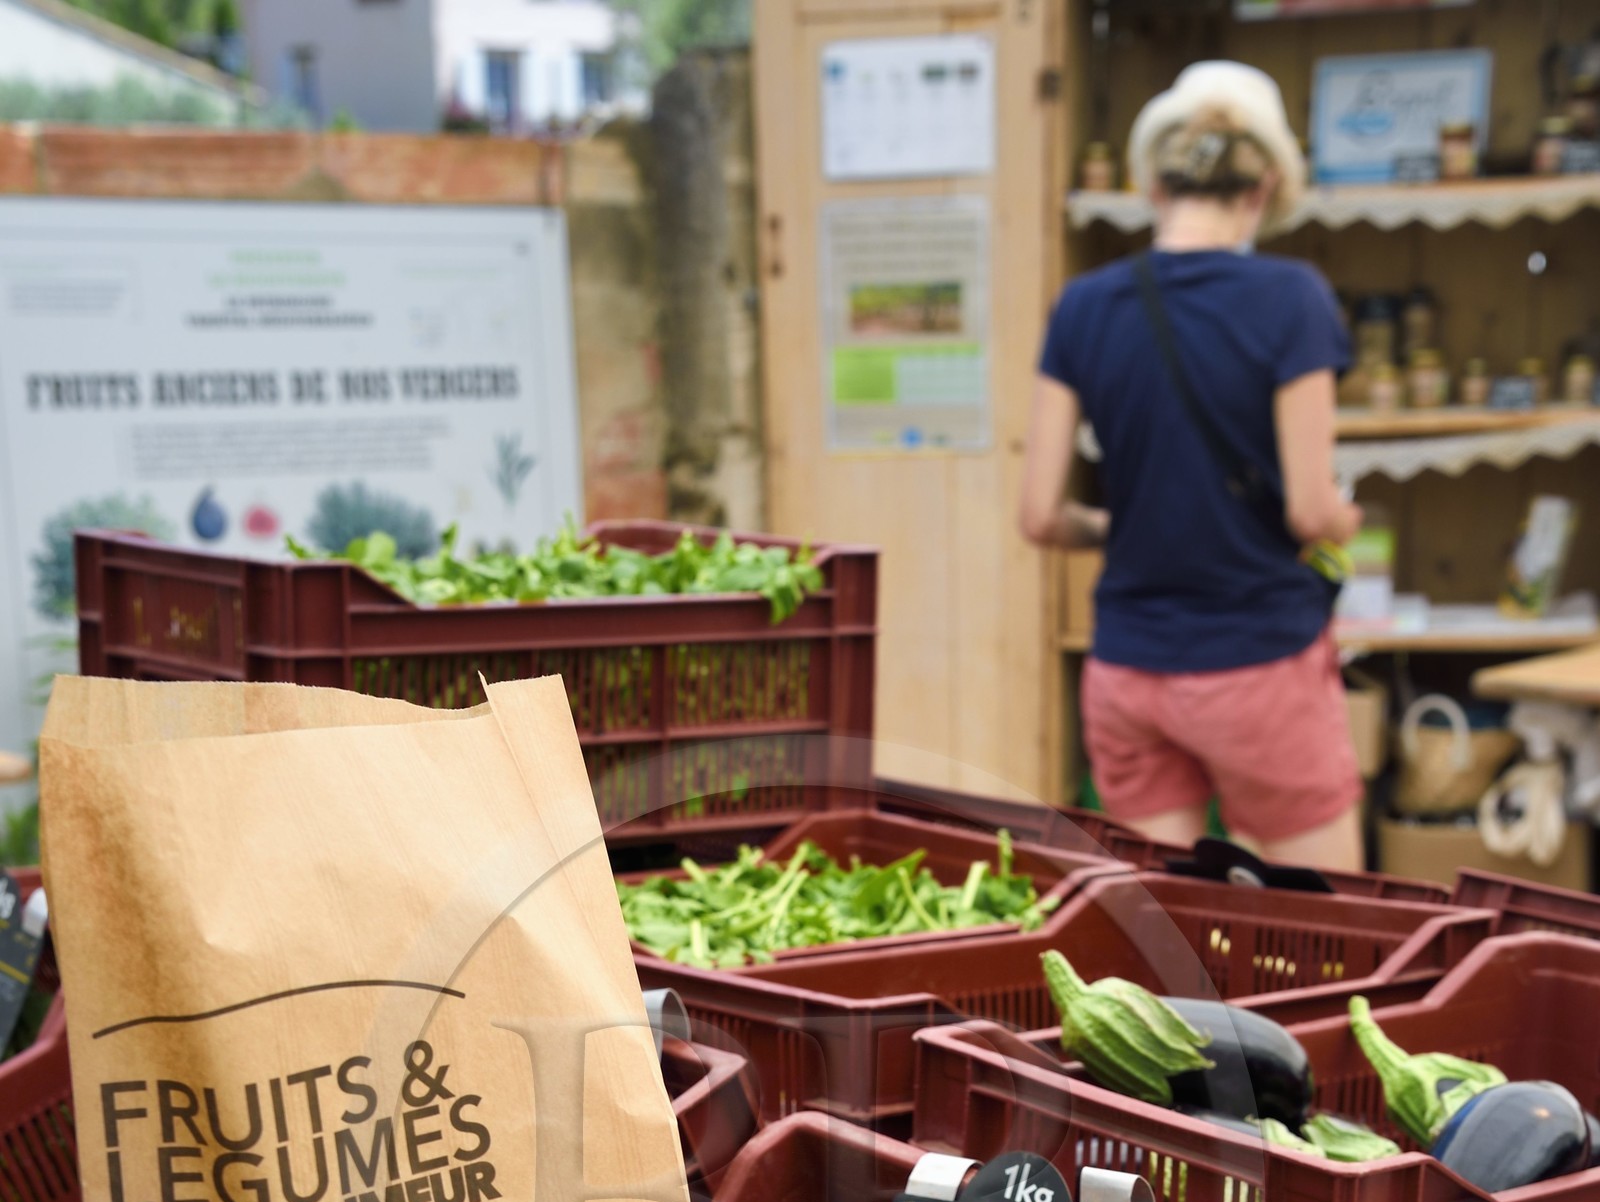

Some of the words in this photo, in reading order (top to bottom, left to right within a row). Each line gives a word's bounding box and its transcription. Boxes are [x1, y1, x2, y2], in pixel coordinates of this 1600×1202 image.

[25, 370, 140, 411] FRUITS
[291, 369, 326, 404] DE
[101, 1056, 377, 1151] FRUITS
[402, 1040, 455, 1107] &
